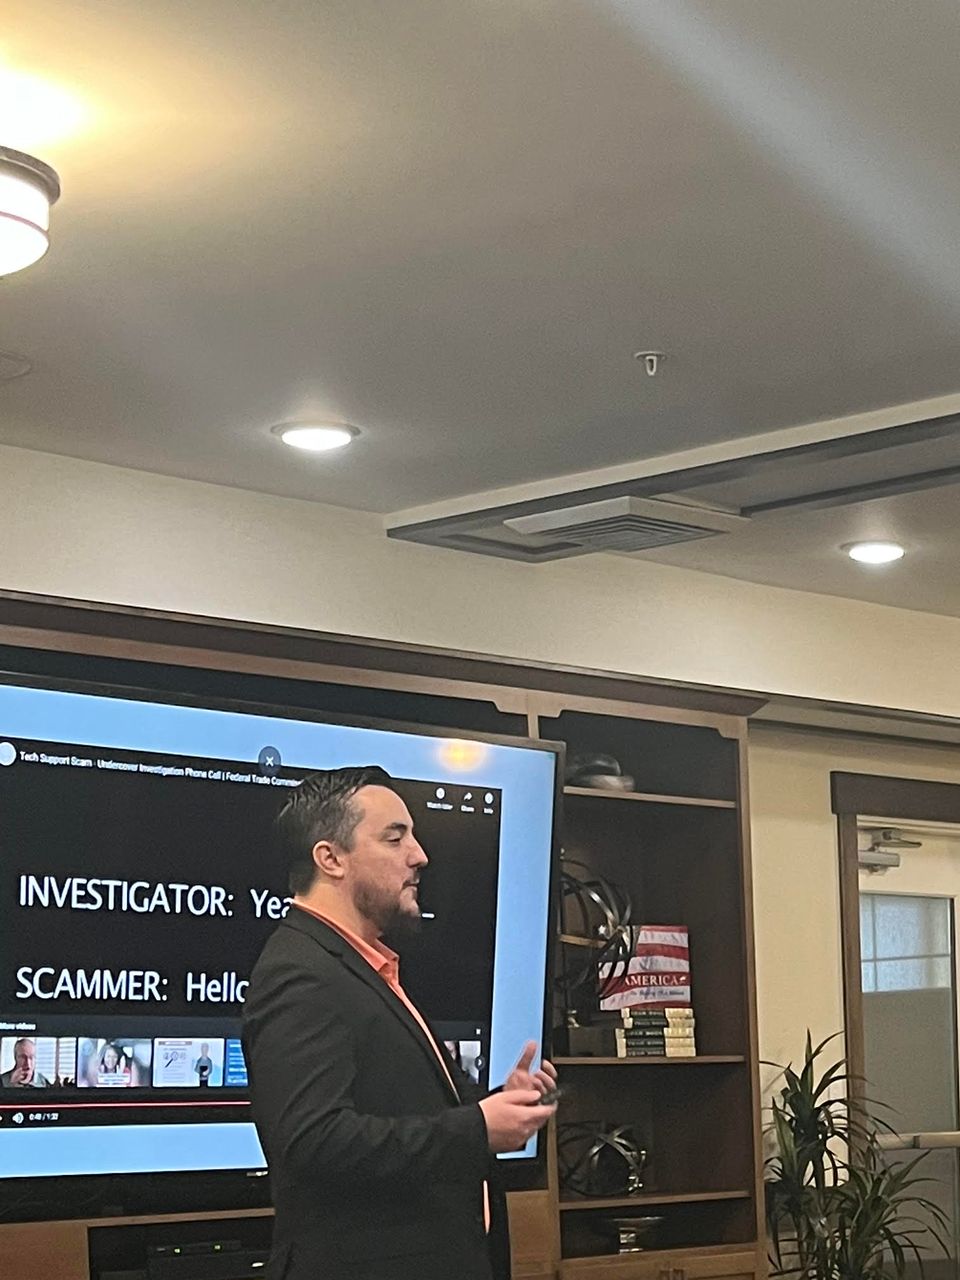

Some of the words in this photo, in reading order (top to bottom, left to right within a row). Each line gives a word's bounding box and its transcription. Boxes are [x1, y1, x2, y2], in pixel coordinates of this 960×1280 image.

[19, 750, 40, 763] Tech
[40, 753, 71, 766] Support
[70, 756, 93, 767] Scam
[97, 759, 139, 772] Undercover
[139, 763, 185, 777] Investigation
[184, 767, 208, 779] Phone
[207, 769, 222, 780] Call
[225, 771, 251, 783] Federal
[251, 774, 271, 785] Trade
[19, 874, 235, 917] INVESTIGATOR:
[16, 966, 169, 1001] SCAMMER:
[625, 975, 679, 986] AMERICA
